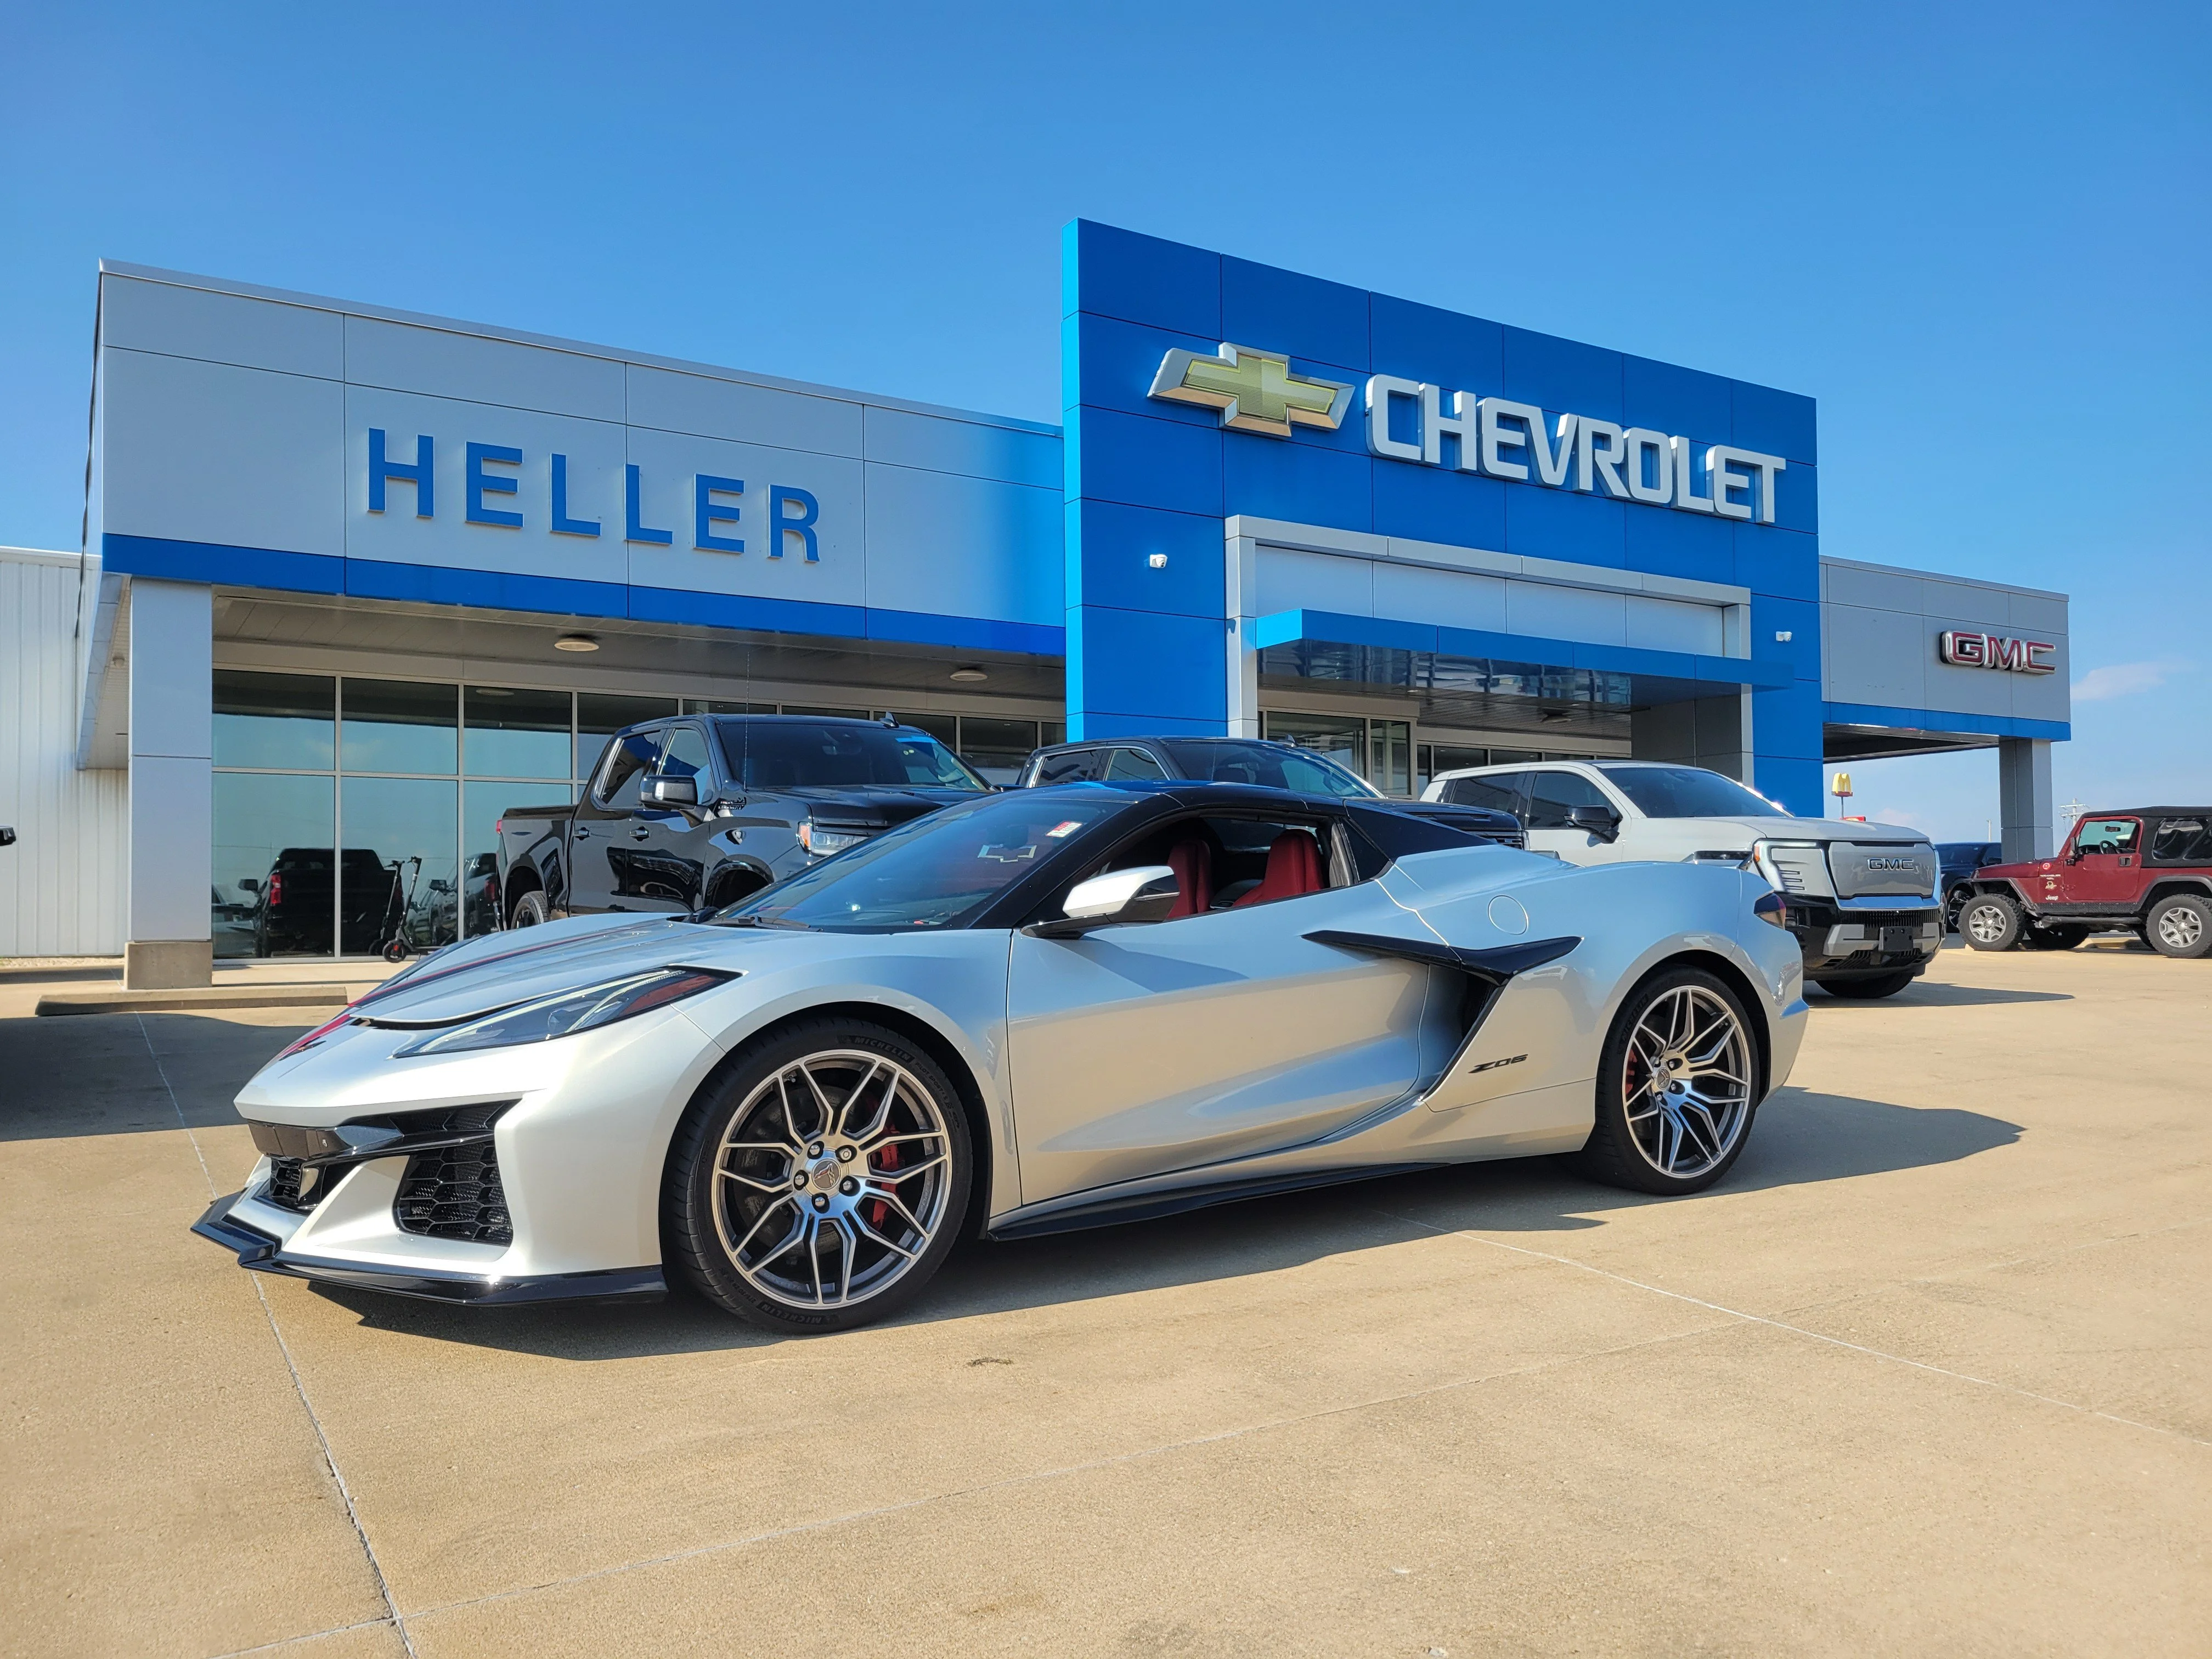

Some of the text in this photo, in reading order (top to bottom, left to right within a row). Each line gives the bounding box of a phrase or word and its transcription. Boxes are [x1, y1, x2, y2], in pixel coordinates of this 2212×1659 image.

[1365, 374, 1787, 525] CHEVROLET
[367, 427, 820, 563] HELLER
[1939, 630, 2056, 674] GMC
[1867, 857, 1914, 871] GMC
[854, 1036, 911, 1061] MICHELIN
[1468, 1053, 1528, 1074] Z06
[760, 1302, 822, 1324] MICHELIN
